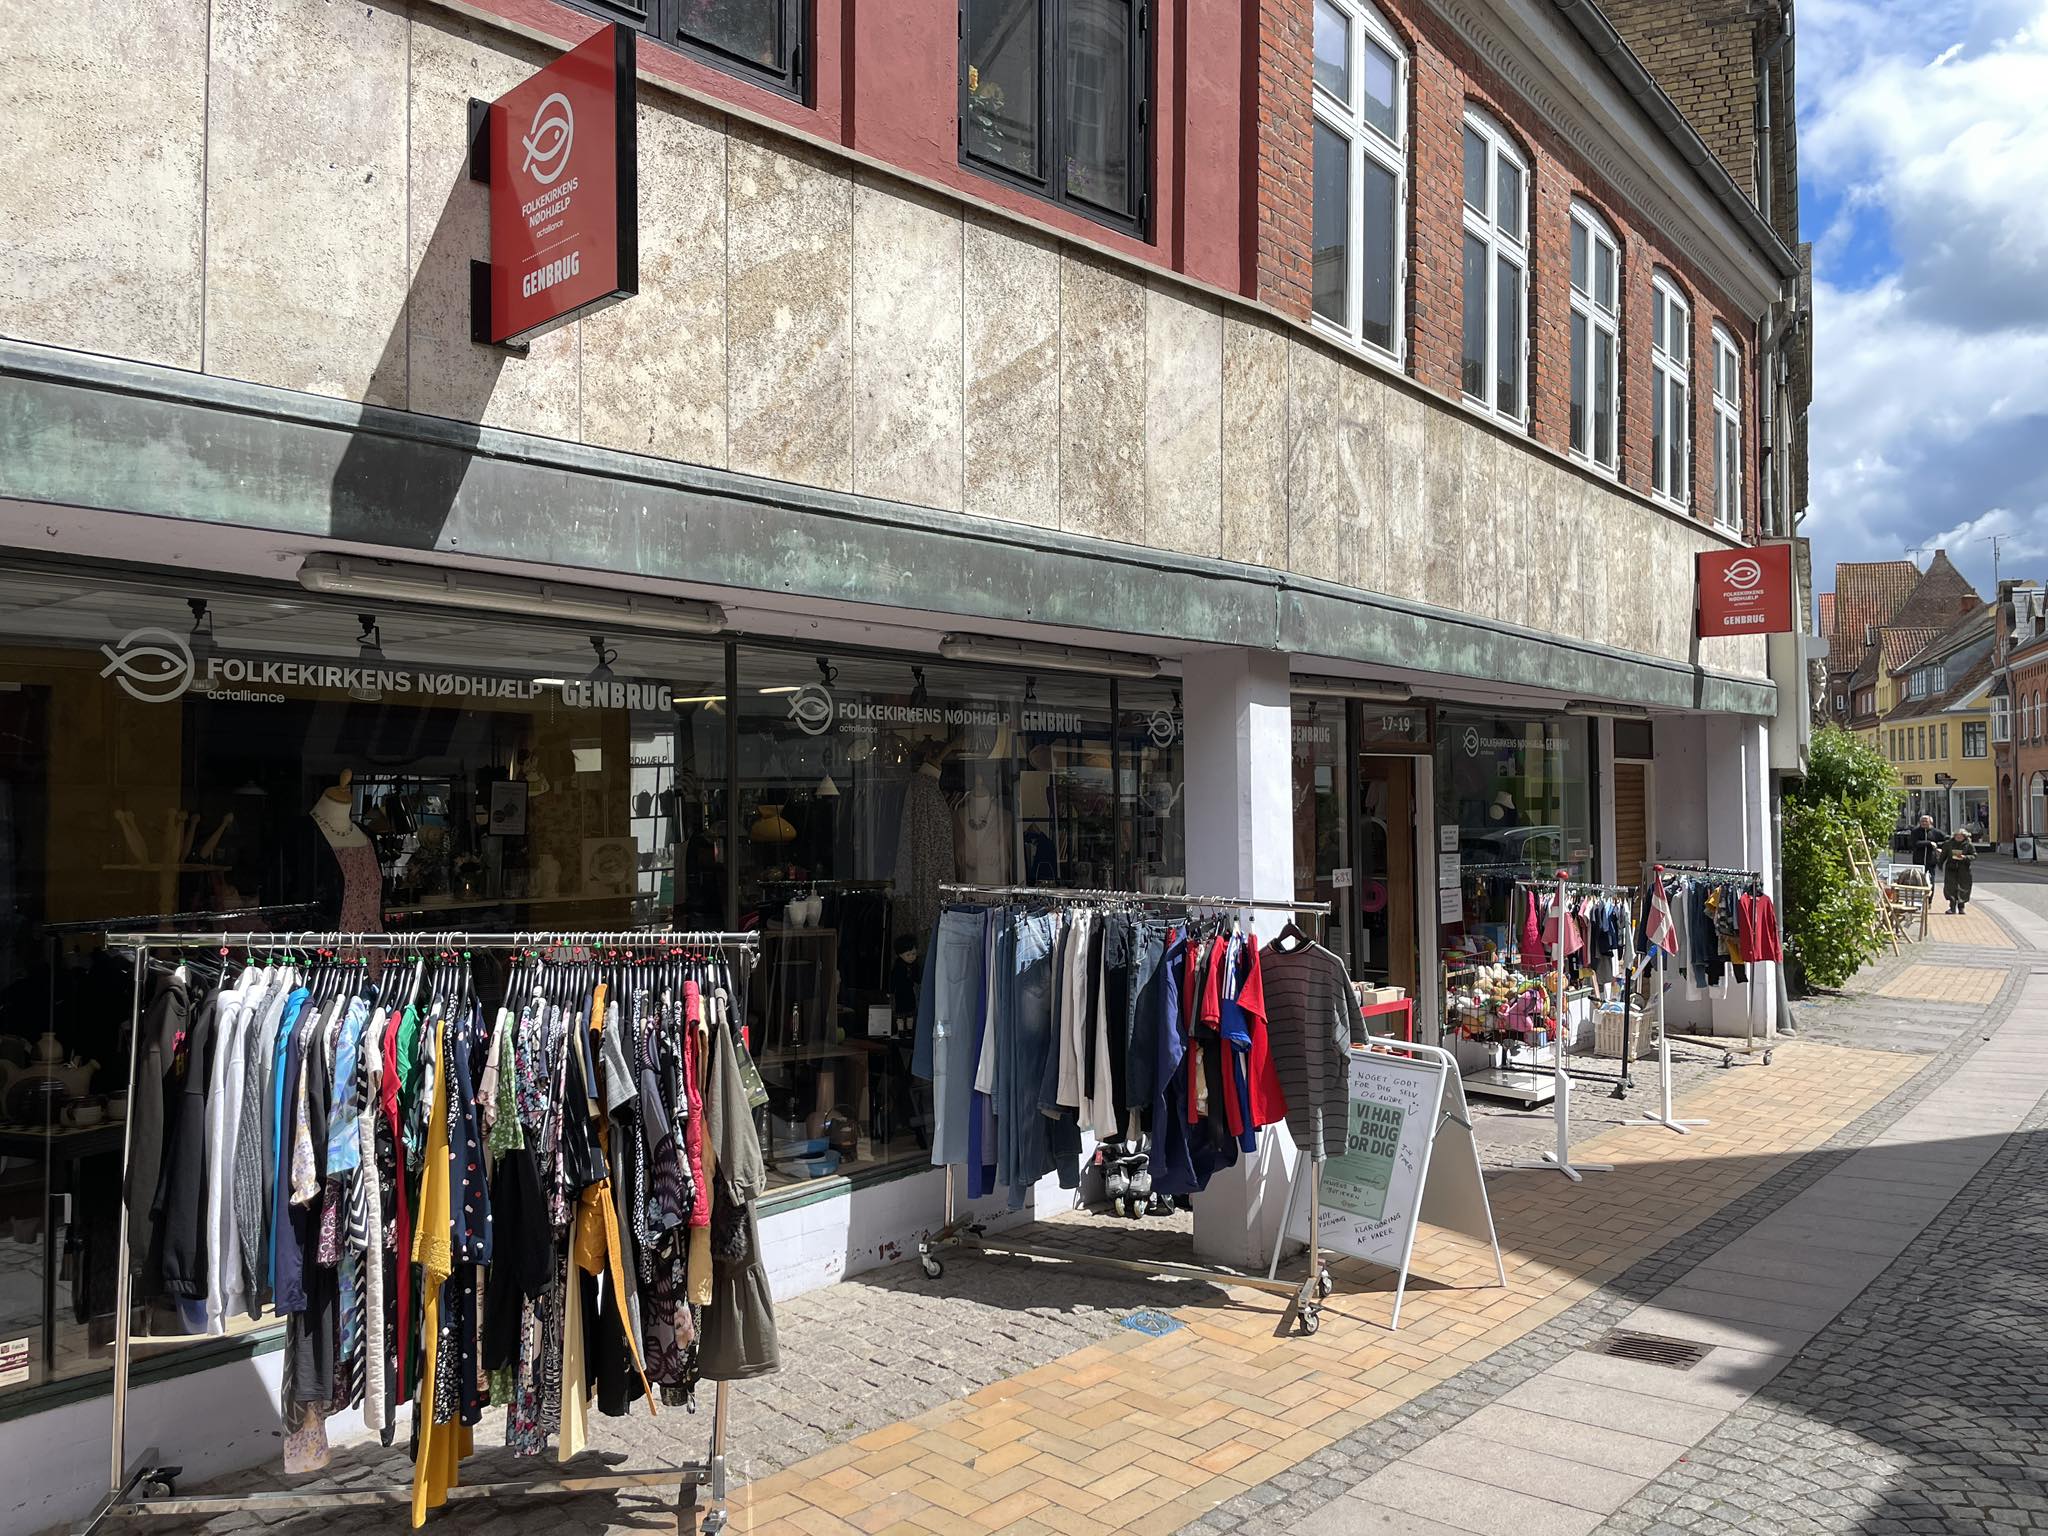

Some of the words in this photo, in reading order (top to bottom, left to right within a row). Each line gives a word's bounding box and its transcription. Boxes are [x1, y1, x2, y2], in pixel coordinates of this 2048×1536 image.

[522, 177, 579, 217] FOLKEKIRKENS
[529, 197, 571, 228] NØDHJÆLP
[536, 219, 564, 238] actalliance
[522, 251, 580, 298] GENBRUG
[1723, 614, 1765, 625] GENBRUG
[207, 657, 411, 692] FOLKEKIRKENS
[418, 673, 543, 699] NØDHJÆLP
[562, 680, 672, 712] GENBRUG
[207, 688, 285, 703] actalliance
[839, 703, 941, 723] FOLKEKIRKENS
[945, 708, 1009, 726] NØDHJÆLP
[1020, 710, 1082, 733] GENBRUG
[1381, 716, 1410, 732] 17-19
[1358, 1071, 1387, 1083] NOGET
[1393, 1078, 1419, 1088] GODT
[1361, 1090, 1376, 1099] OG
[1377, 1084, 1391, 1093] DIG
[1400, 1089, 1418, 1099] SELV
[1357, 1103, 1370, 1119] VI
[1371, 1106, 1402, 1126] HAR
[1360, 1120, 1399, 1142] BRUG
[1348, 1133, 1369, 1152] OR
[1370, 1140, 1396, 1158] DIG
[1357, 1236, 1367, 1245] AF
[1371, 1227, 1395, 1240] VARER
